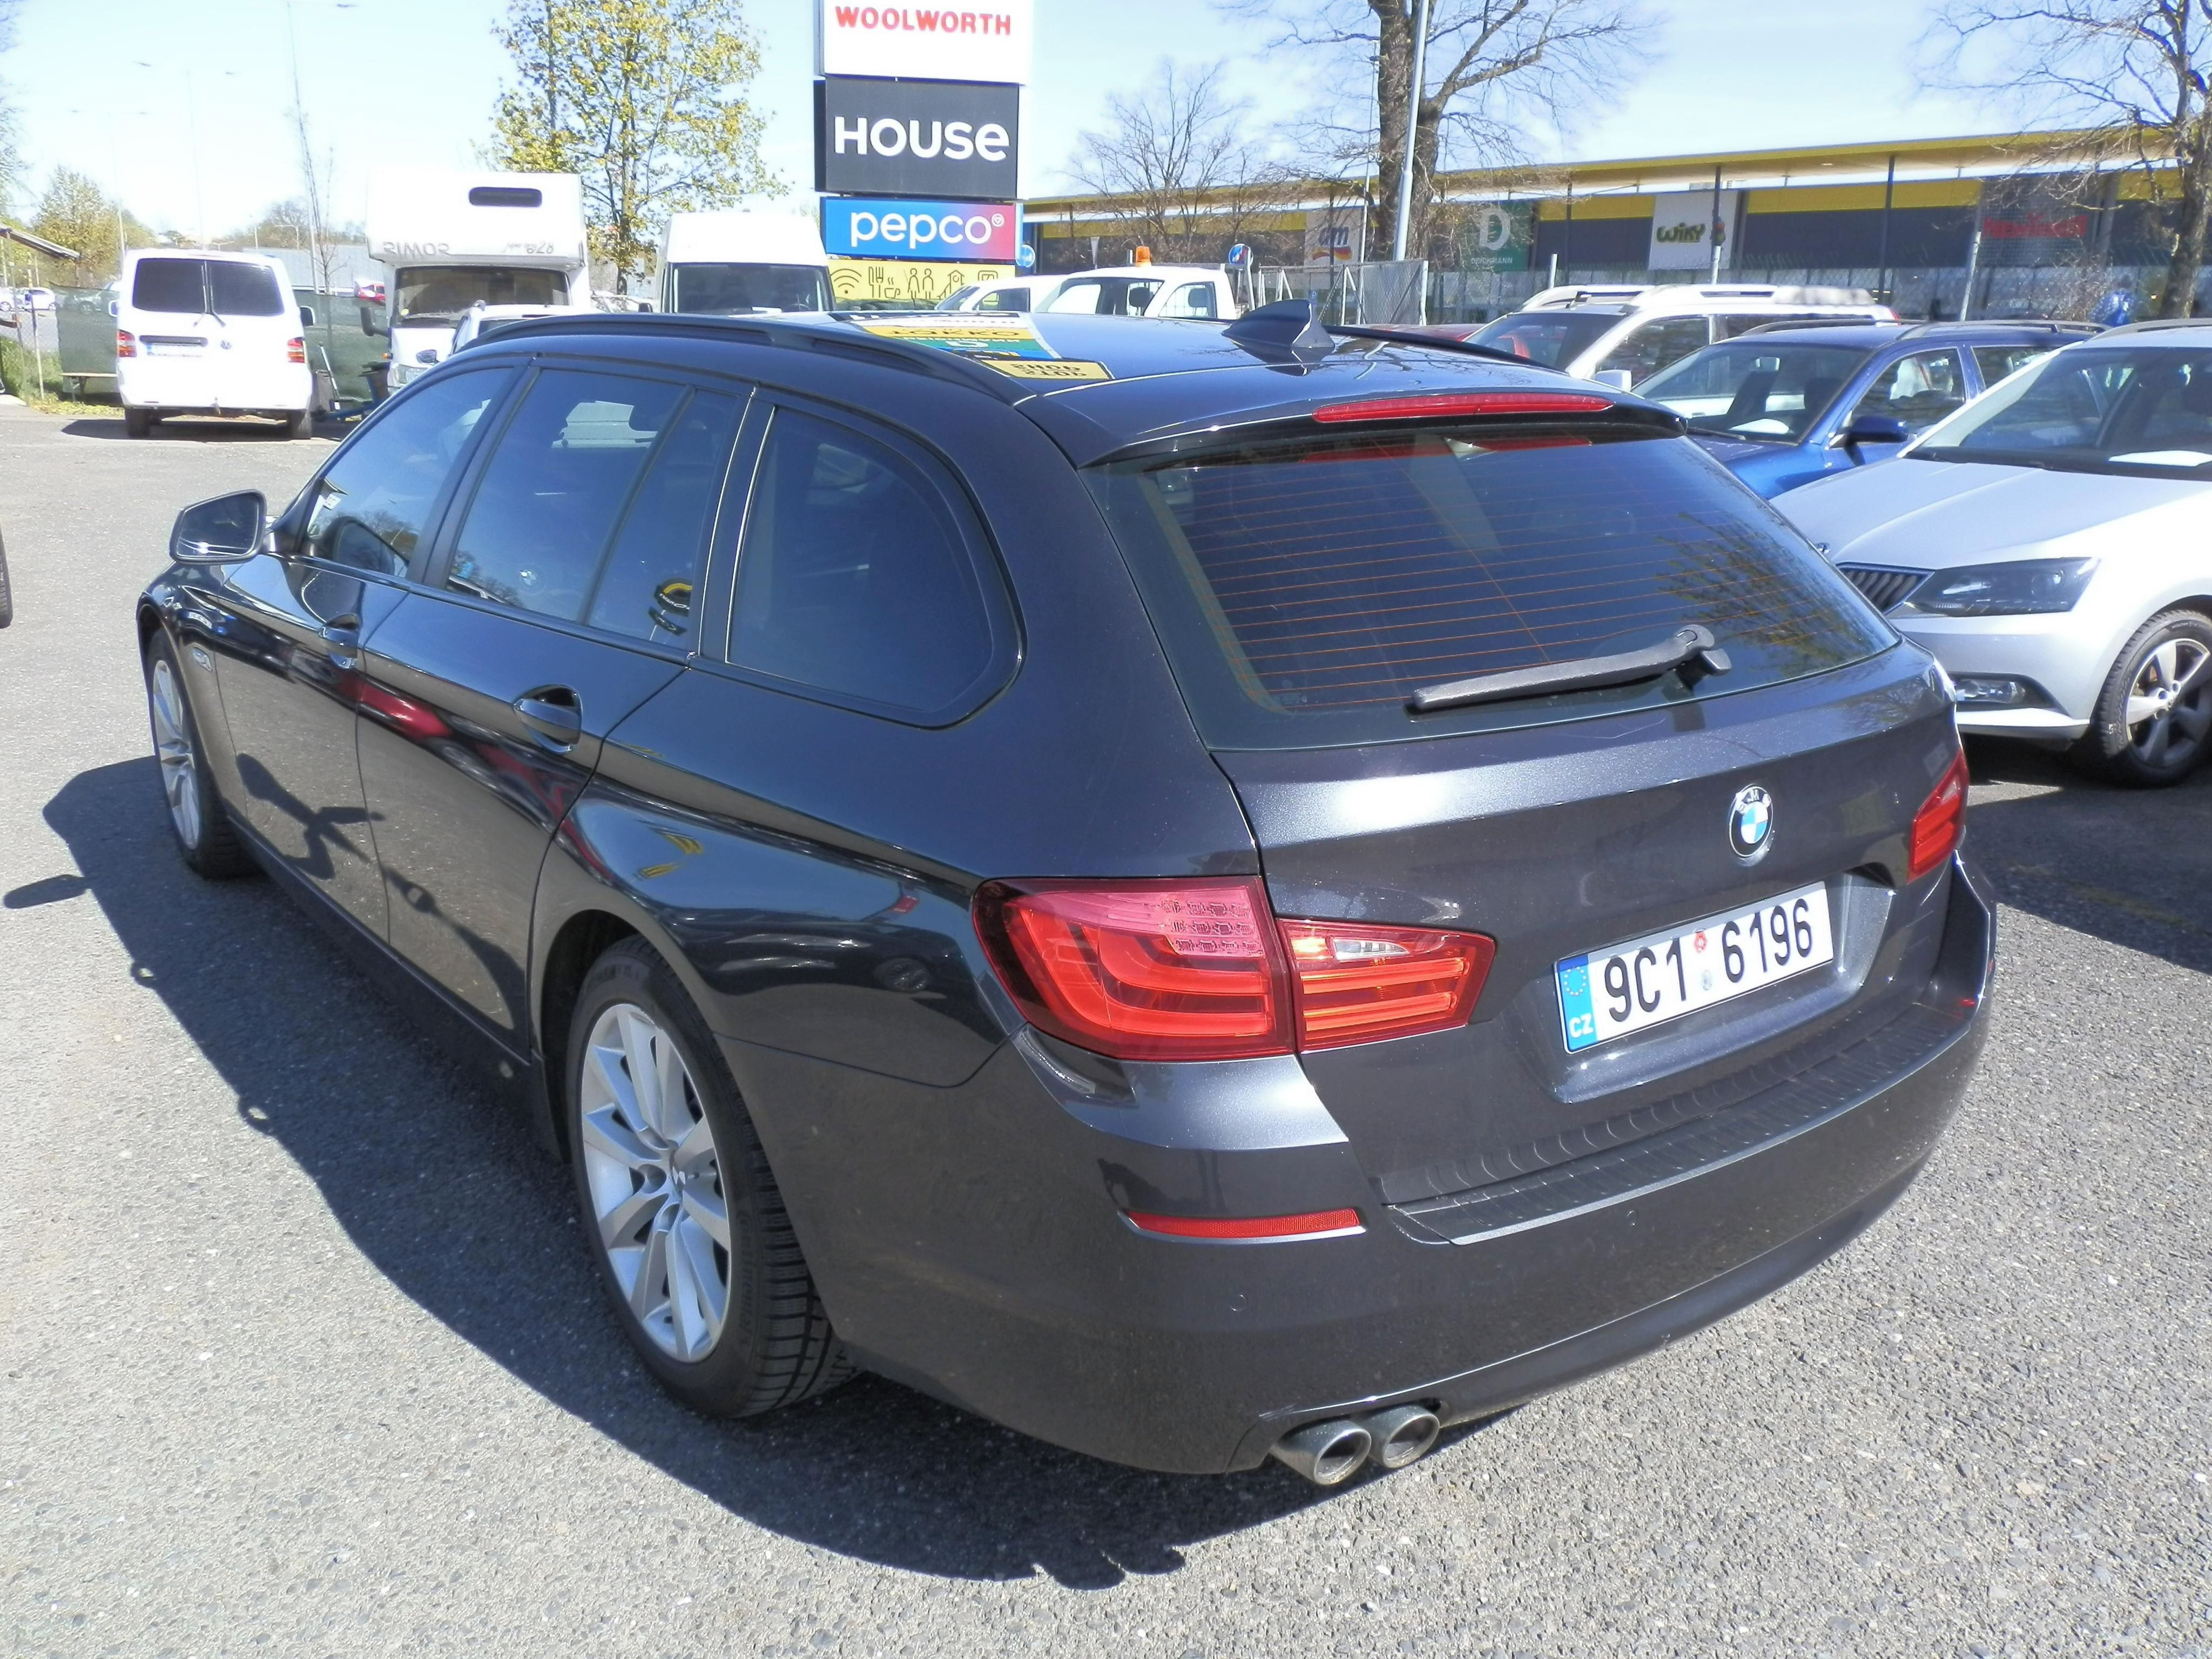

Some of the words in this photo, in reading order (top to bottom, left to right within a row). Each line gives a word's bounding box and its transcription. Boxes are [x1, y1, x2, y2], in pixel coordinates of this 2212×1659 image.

[835, 6, 1011, 35] WOOLWORTH
[851, 212, 992, 249] pepco
[1318, 226, 1349, 245] dm
[1604, 938, 1687, 1022] 9C1
[1722, 898, 1812, 983] 6196
[1569, 1013, 1594, 1038] CZ
